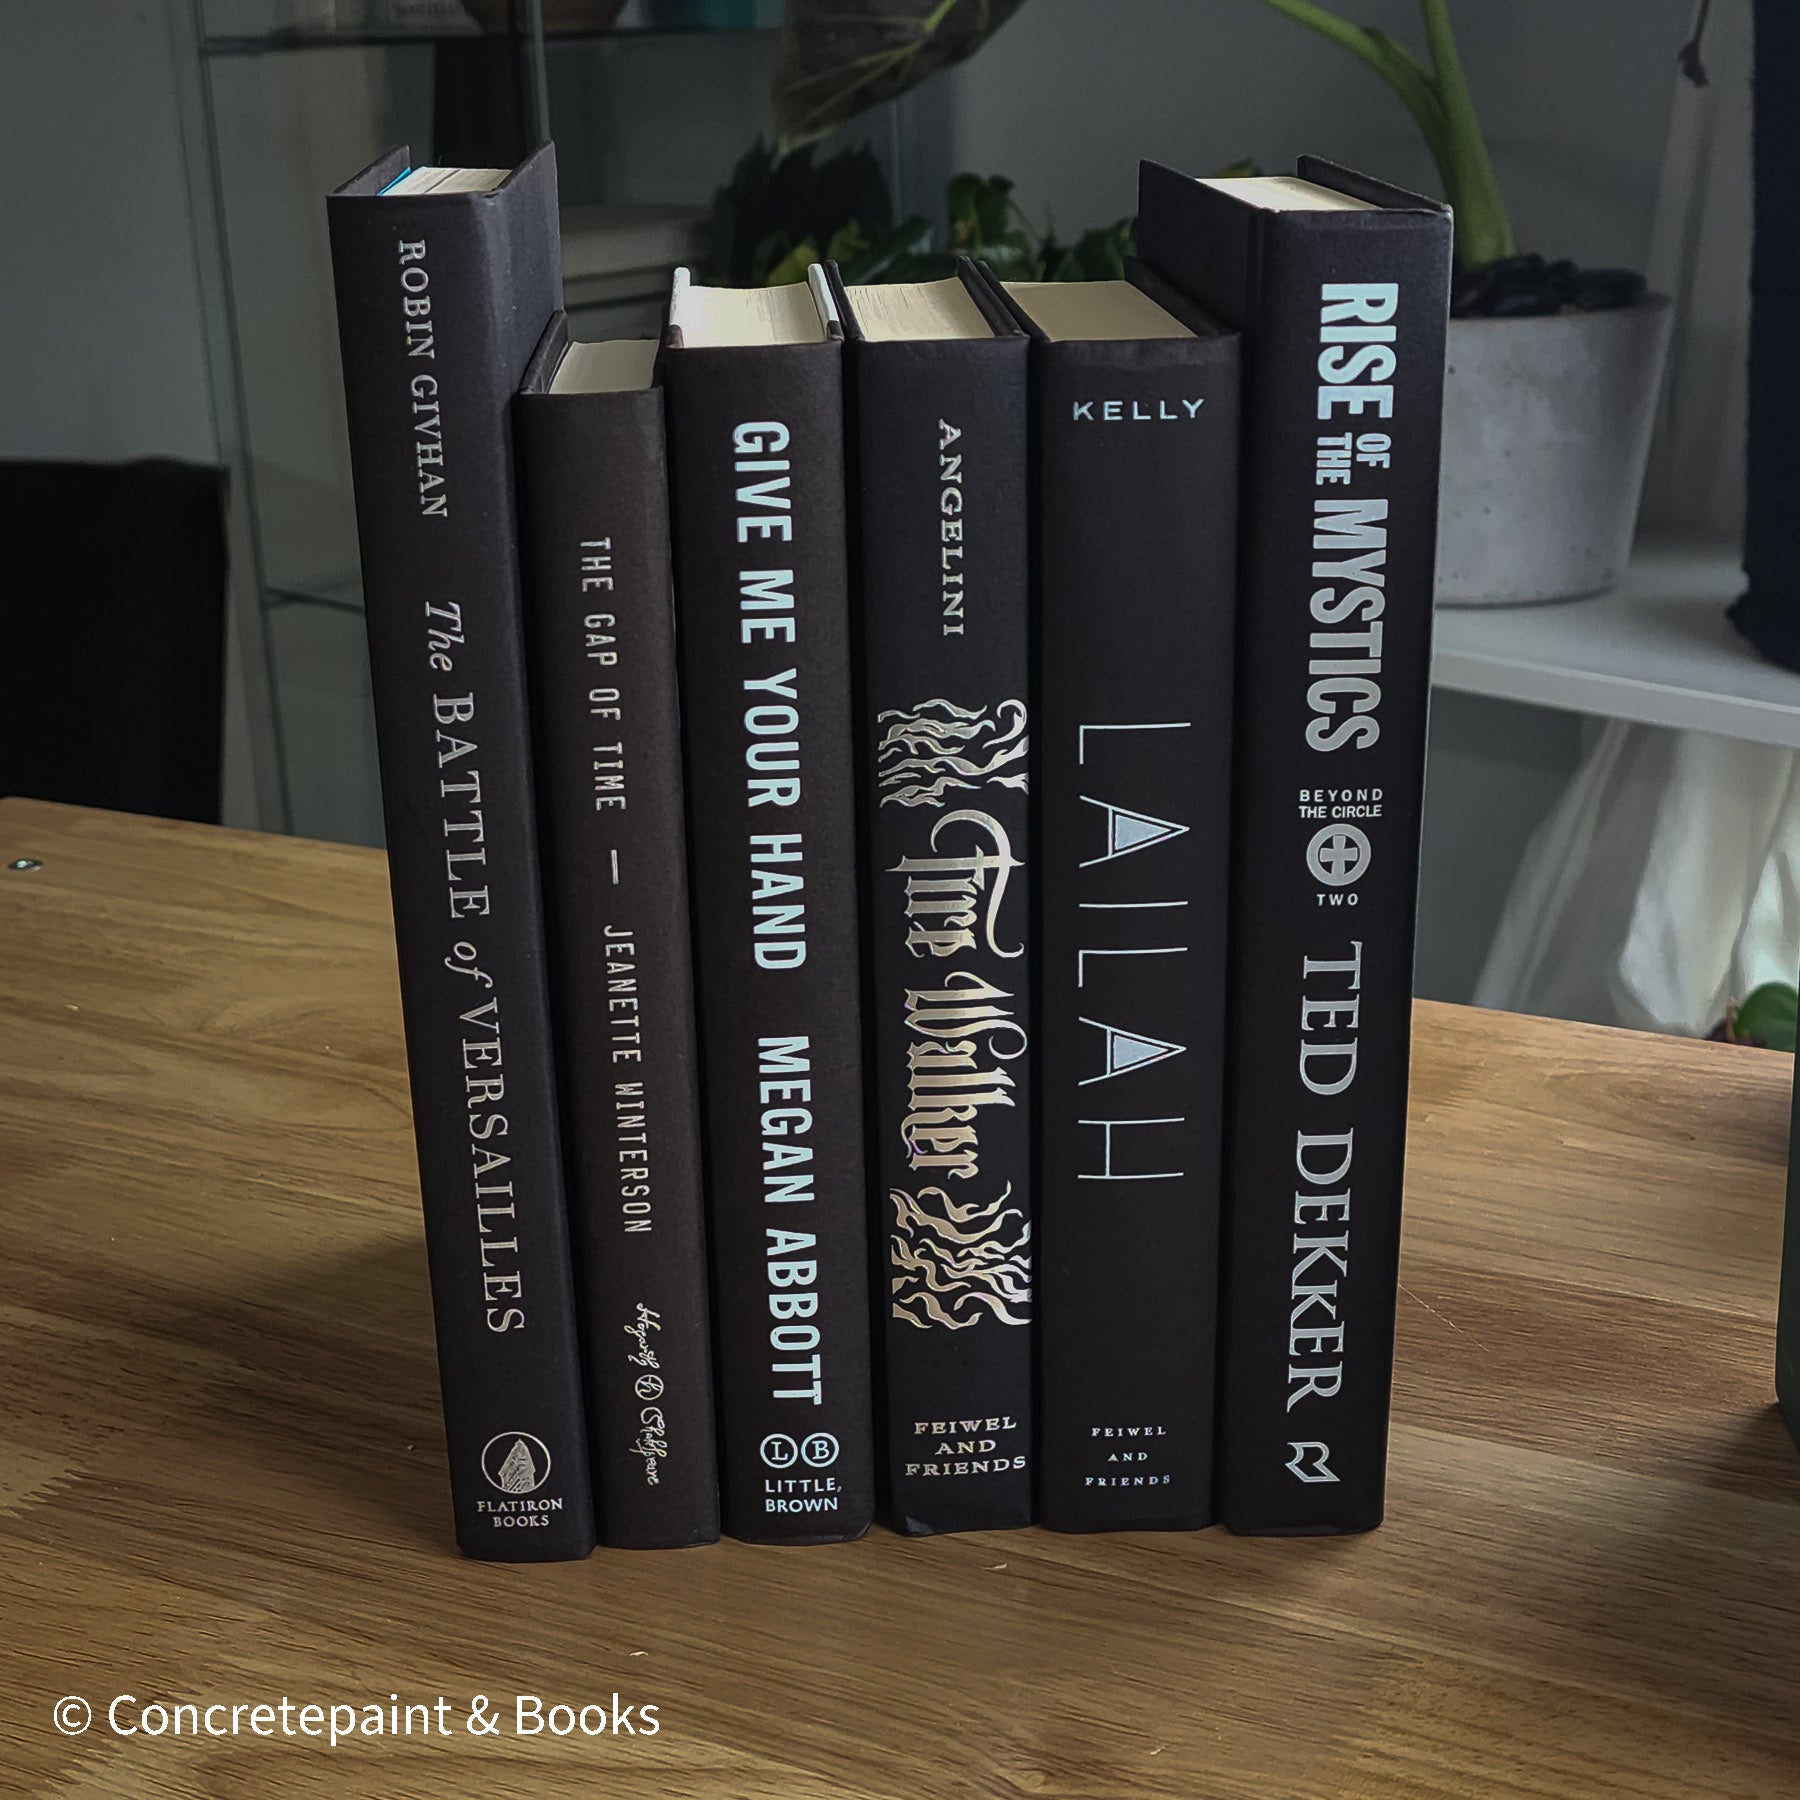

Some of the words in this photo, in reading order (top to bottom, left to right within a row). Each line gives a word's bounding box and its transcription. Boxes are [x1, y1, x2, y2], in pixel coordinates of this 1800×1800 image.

[399, 240, 434, 359] ROBIN
[1318, 283, 1398, 419] RISE
[1074, 399, 1204, 420] KELLY
[411, 375, 447, 517] GIVHAN
[1316, 432, 1352, 485] THE
[1356, 433, 1391, 468] OF
[733, 422, 792, 542] GIVE
[940, 419, 963, 635] ANGELINI
[581, 538, 613, 591] THE
[426, 602, 464, 670] The
[585, 614, 617, 665] GAP
[740, 570, 795, 643] ME
[1306, 499, 1388, 751] MYSTICS
[589, 689, 620, 720] OF
[744, 668, 800, 807] YOUR
[434, 692, 489, 918] BATTLE
[594, 742, 625, 810] TIME
[1300, 789, 1382, 802] BEYOND
[1299, 806, 1327, 818] THE
[1332, 805, 1382, 818] CIRCLE
[750, 834, 806, 969] HAND
[886, 810, 1025, 957] Fire
[1317, 894, 1358, 905] TWO
[445, 942, 492, 988] of
[1078, 723, 1191, 1179] LAILAH
[604, 926, 641, 1062] JEANETTE
[1300, 941, 1362, 1095] TED
[901, 972, 1027, 1178] Walker
[758, 1036, 814, 1202] MEGAN
[460, 997, 524, 1332] VERSAILLES
[615, 1083, 652, 1231] WINTERSON
[1287, 1128, 1353, 1412] DEKKER
[766, 1229, 821, 1405] ABBOTT
[915, 1417, 1016, 1434] FEIWEL
[935, 1440, 996, 1454] AND
[1092, 1427, 1165, 1436] FEIWEL
[1108, 1453, 1147, 1461] AND
[766, 1478, 841, 1492] LITTLE,
[906, 1456, 1025, 1475] FRIENDS
[1086, 1475, 1169, 1485] FRIENDS
[478, 1498, 562, 1511] FLATIRON
[494, 1515, 549, 1527] BOOKS
[766, 1497, 837, 1512] BROWN
